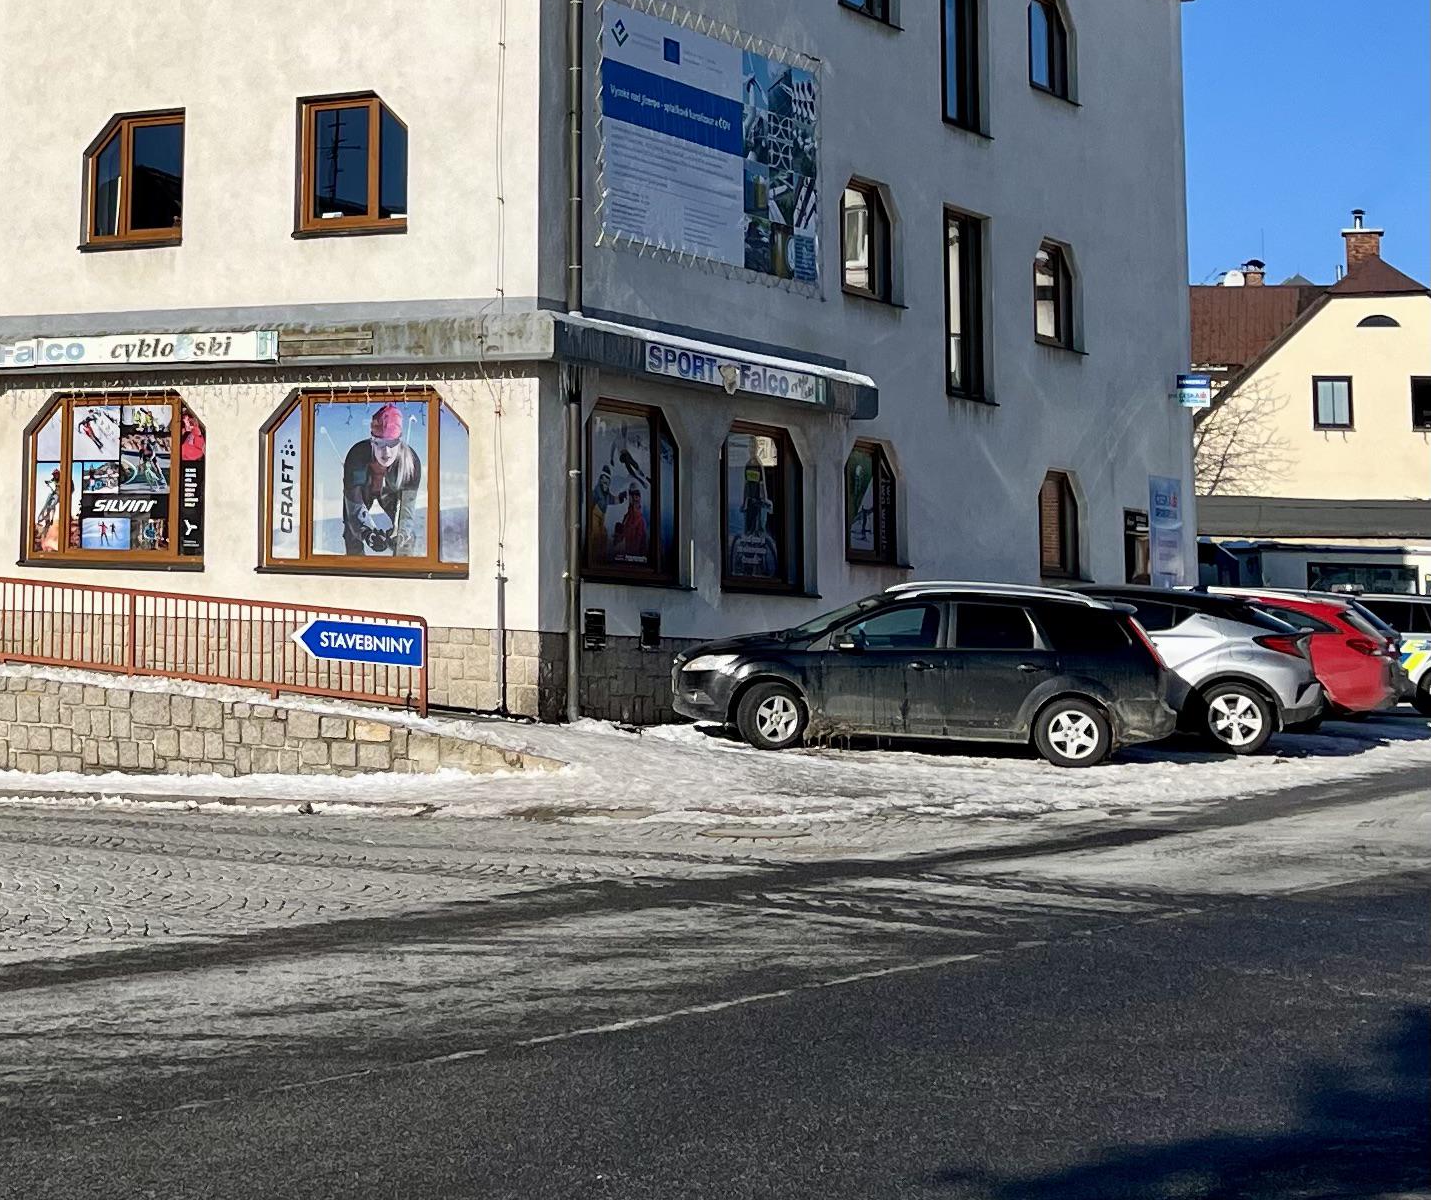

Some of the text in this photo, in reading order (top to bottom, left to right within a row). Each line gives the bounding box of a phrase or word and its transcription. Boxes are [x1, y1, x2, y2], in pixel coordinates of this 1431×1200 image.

[111, 337, 175, 364] cyklo
[193, 335, 232, 357] ski
[648, 345, 789, 397] SPORT Falco
[92, 499, 158, 513] SILVINI
[280, 458, 295, 534] CRAFT
[319, 631, 414, 655] STAVEBNINY
